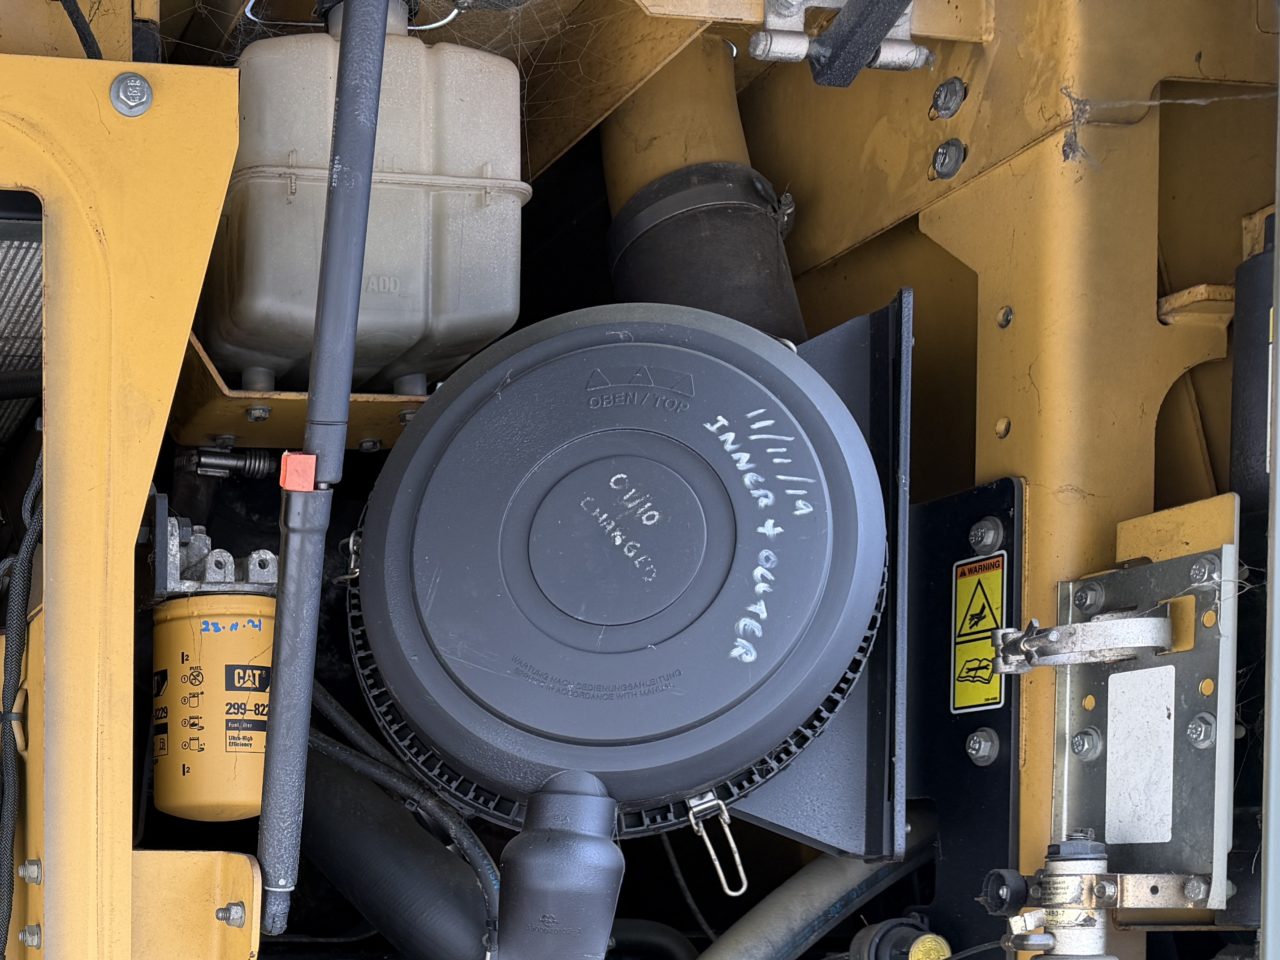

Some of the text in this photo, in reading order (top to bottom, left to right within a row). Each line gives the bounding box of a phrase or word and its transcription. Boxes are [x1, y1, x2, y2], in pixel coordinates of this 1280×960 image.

[366, 276, 401, 293] ADD
[588, 391, 638, 410] OBEN
[653, 396, 691, 413] TOP
[703, 415, 775, 509] INNER
[966, 560, 1001, 576] WARNING
[234, 669, 261, 688] CAT
